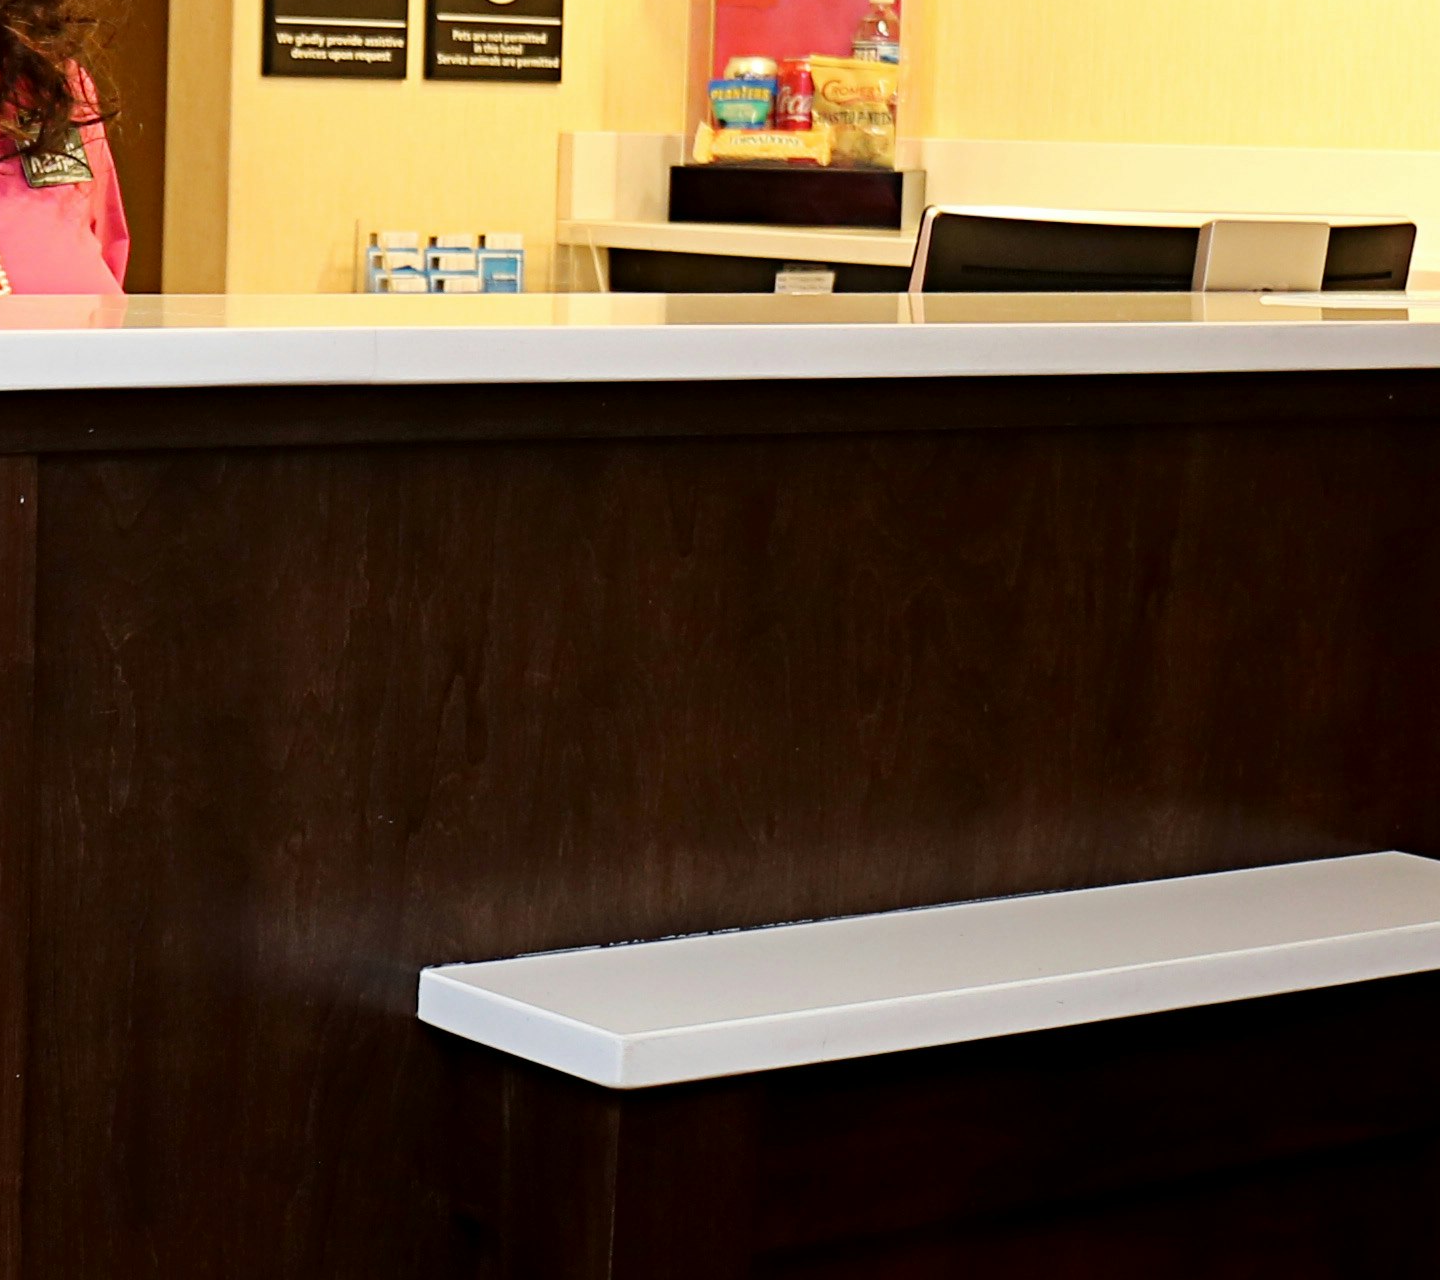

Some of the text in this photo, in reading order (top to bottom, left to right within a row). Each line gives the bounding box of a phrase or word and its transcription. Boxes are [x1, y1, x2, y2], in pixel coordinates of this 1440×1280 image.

[276, 31, 404, 48] We gladly provide assistive
[452, 29, 547, 45] Pets are not permitted
[290, 47, 392, 63] devices upon request
[483, 41, 499, 54] this
[499, 42, 524, 55] hotel
[436, 52, 559, 69] Service animals are permitted
